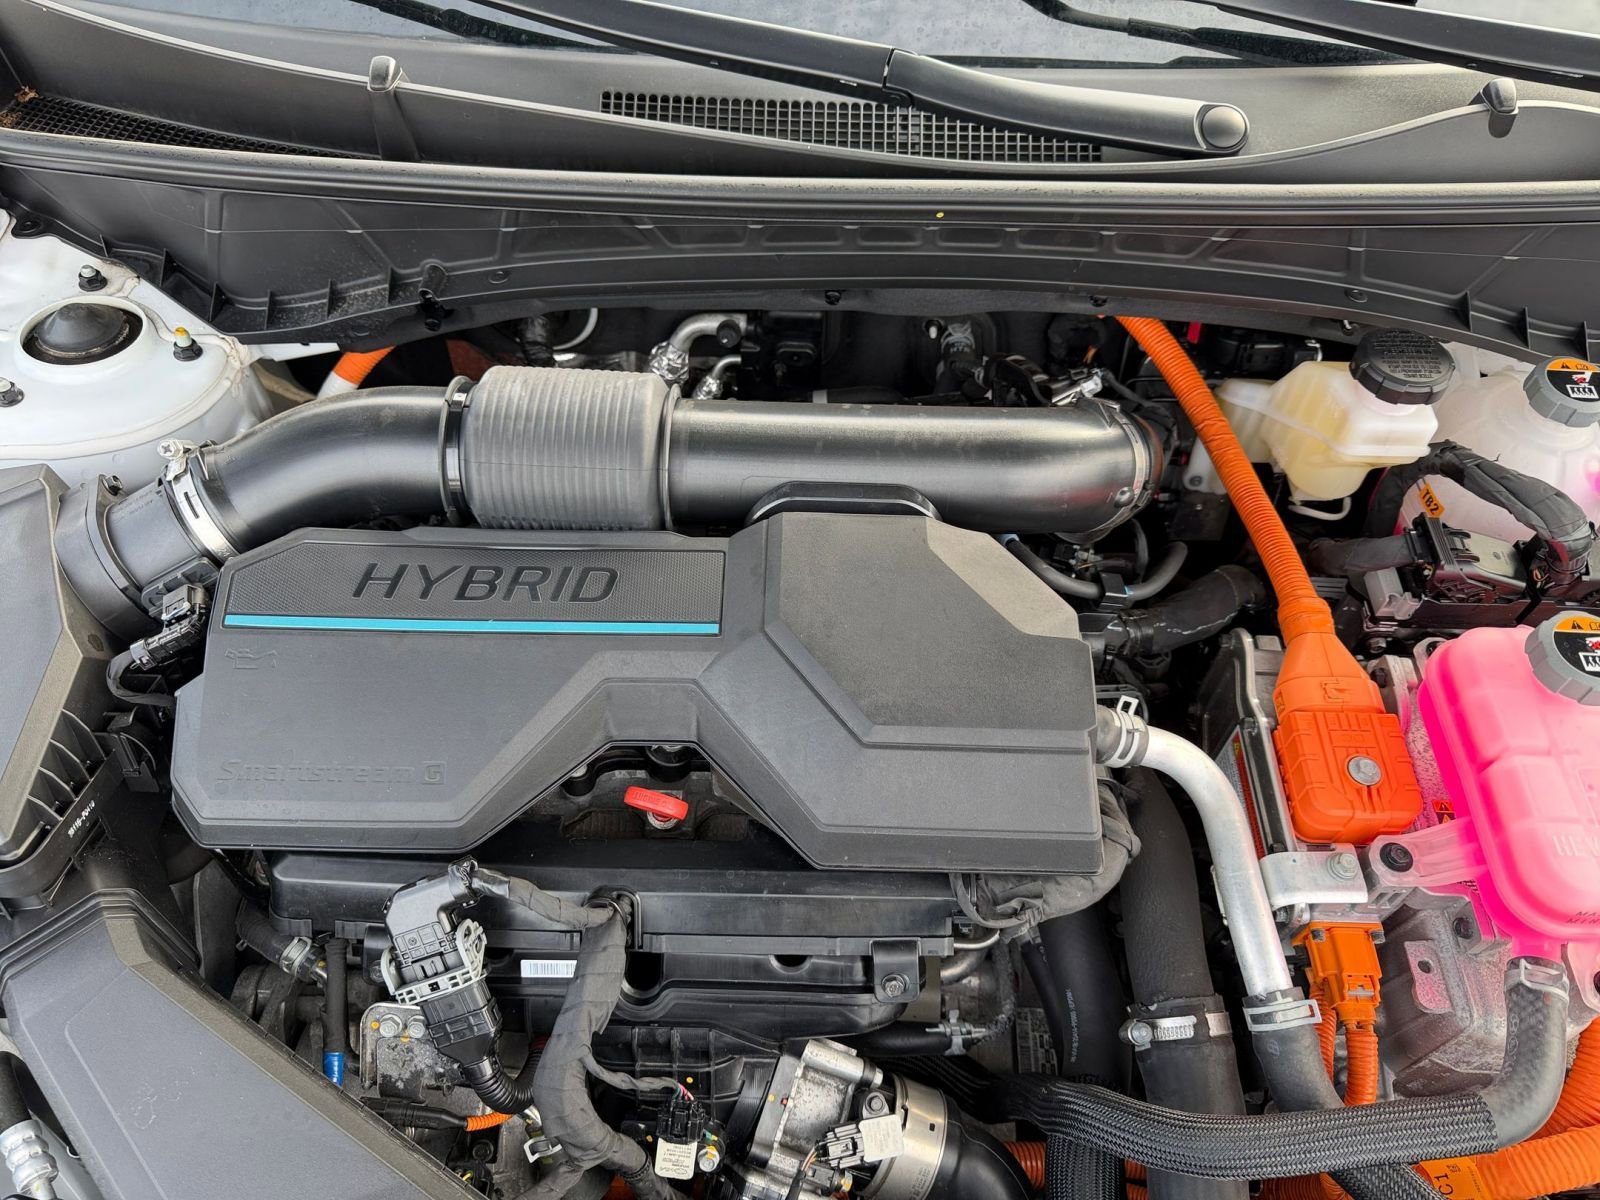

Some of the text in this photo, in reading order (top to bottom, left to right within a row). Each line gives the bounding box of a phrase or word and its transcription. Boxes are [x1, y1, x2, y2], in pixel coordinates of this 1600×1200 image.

[352, 563, 619, 602] HYBRID
[216, 759, 446, 785] Smartstream G
[1434, 1172, 1454, 1196] C1
